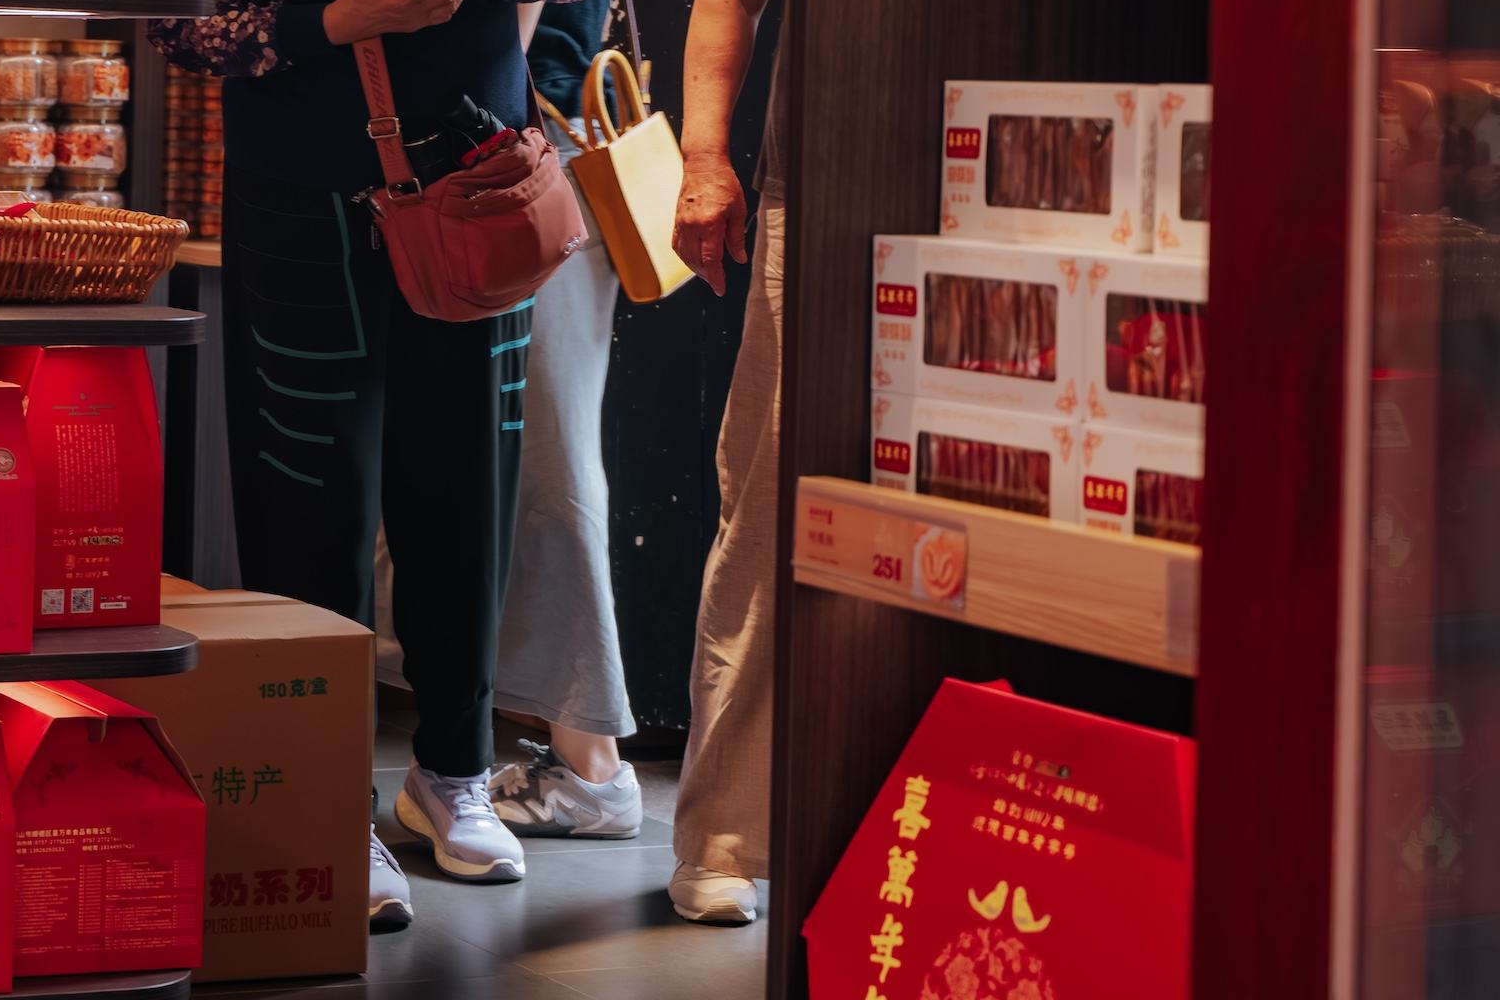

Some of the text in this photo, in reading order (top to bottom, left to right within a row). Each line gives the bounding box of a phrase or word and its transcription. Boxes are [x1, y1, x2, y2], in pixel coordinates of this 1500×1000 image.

[873, 553, 893, 581] 25
[193, 764, 285, 806] 特产
[209, 864, 334, 909] 奶系列
[864, 774, 931, 1000] 喜萬年
[205, 910, 333, 936] PURE BUFFALO MILK
